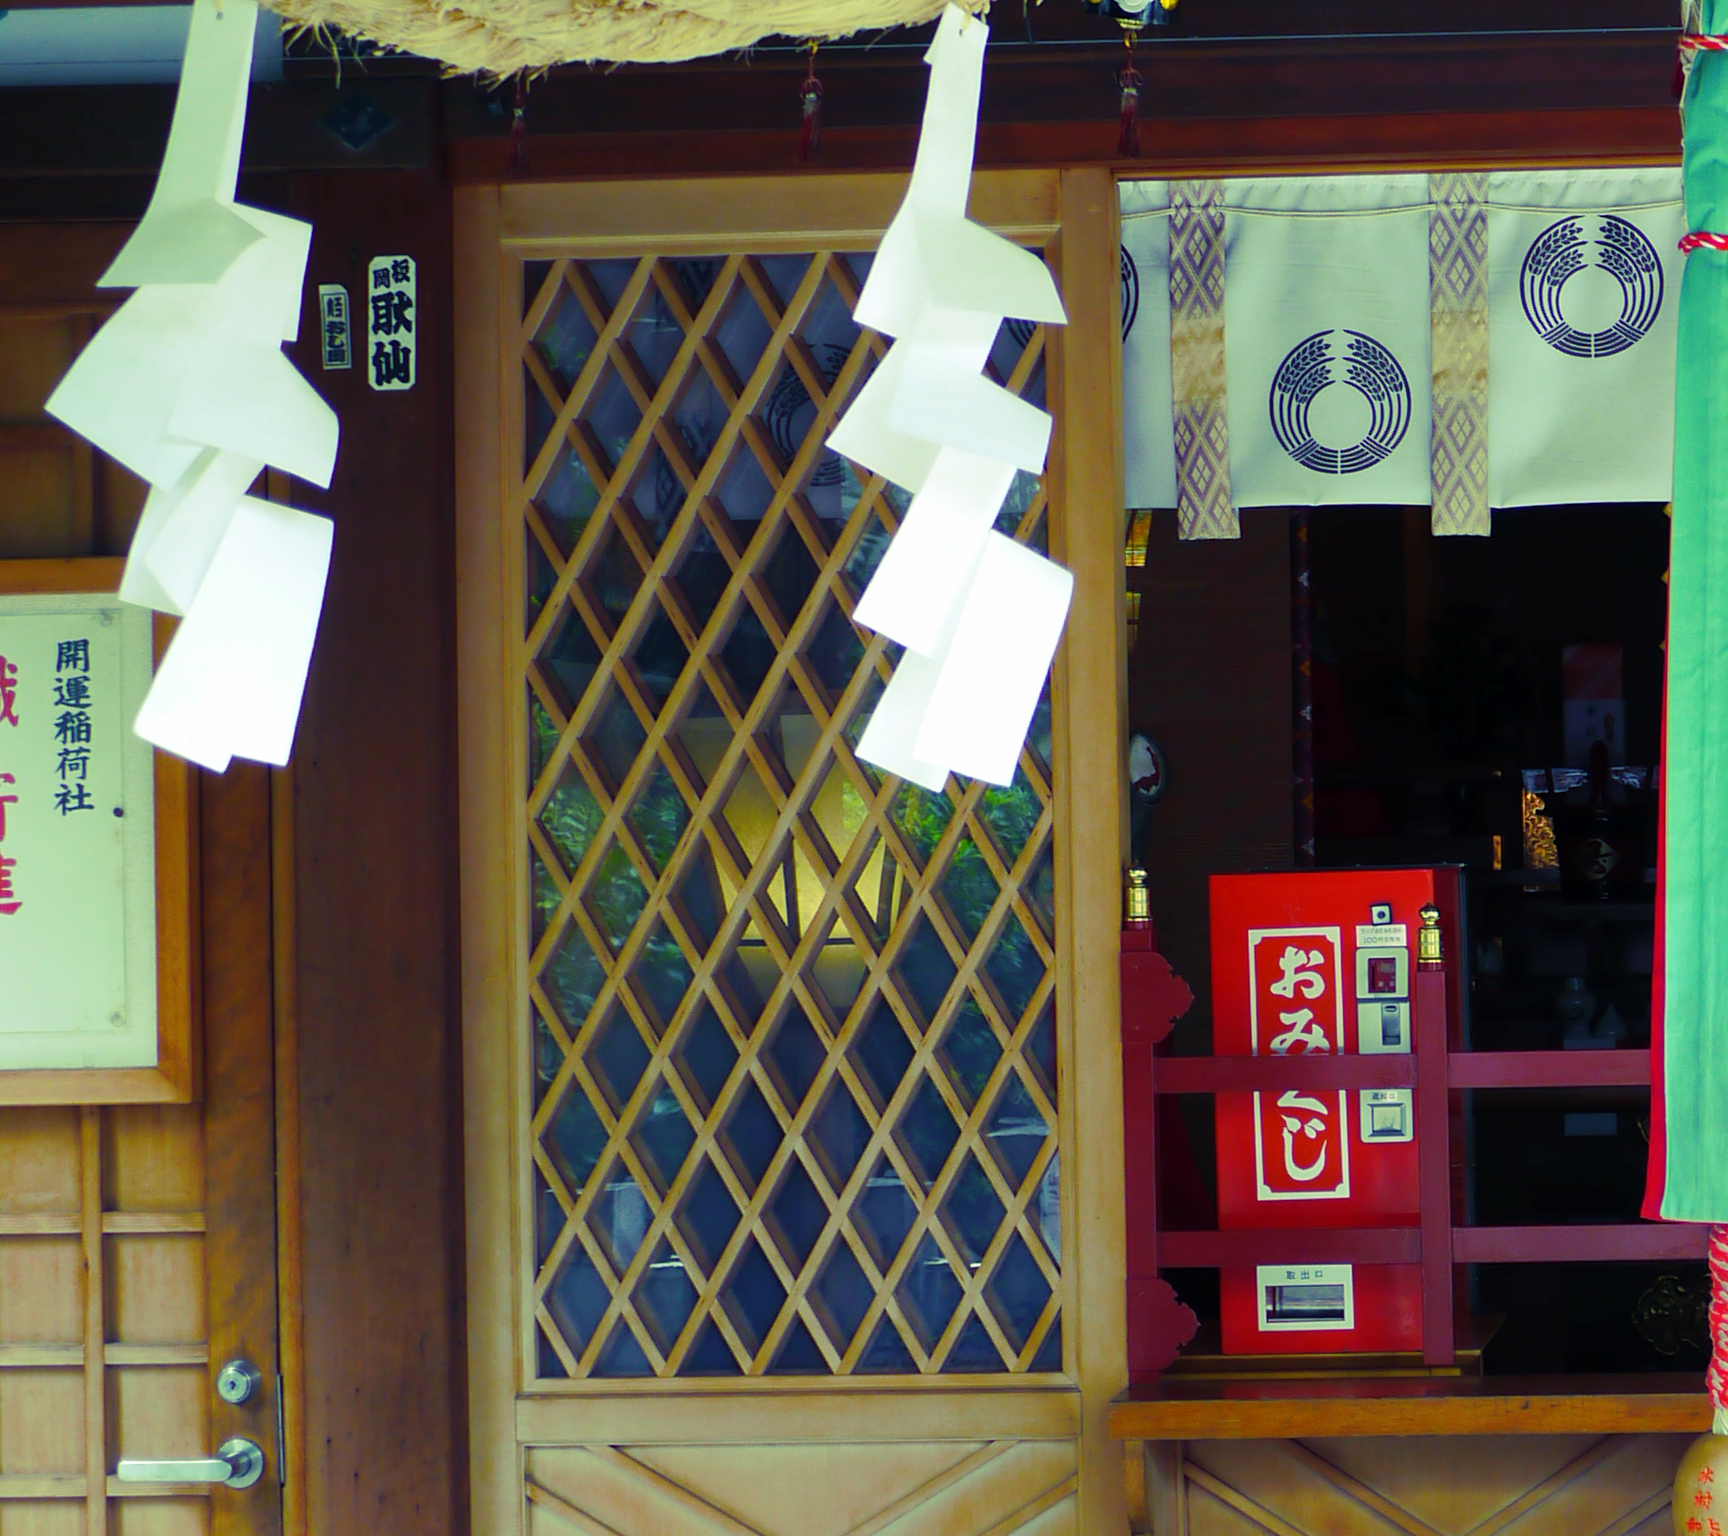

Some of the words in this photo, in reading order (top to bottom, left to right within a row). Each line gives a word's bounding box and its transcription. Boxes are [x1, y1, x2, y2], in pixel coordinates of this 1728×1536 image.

[54, 638, 95, 817] 開運稲荷社
[1285, 1269, 1324, 1281] 取出口
